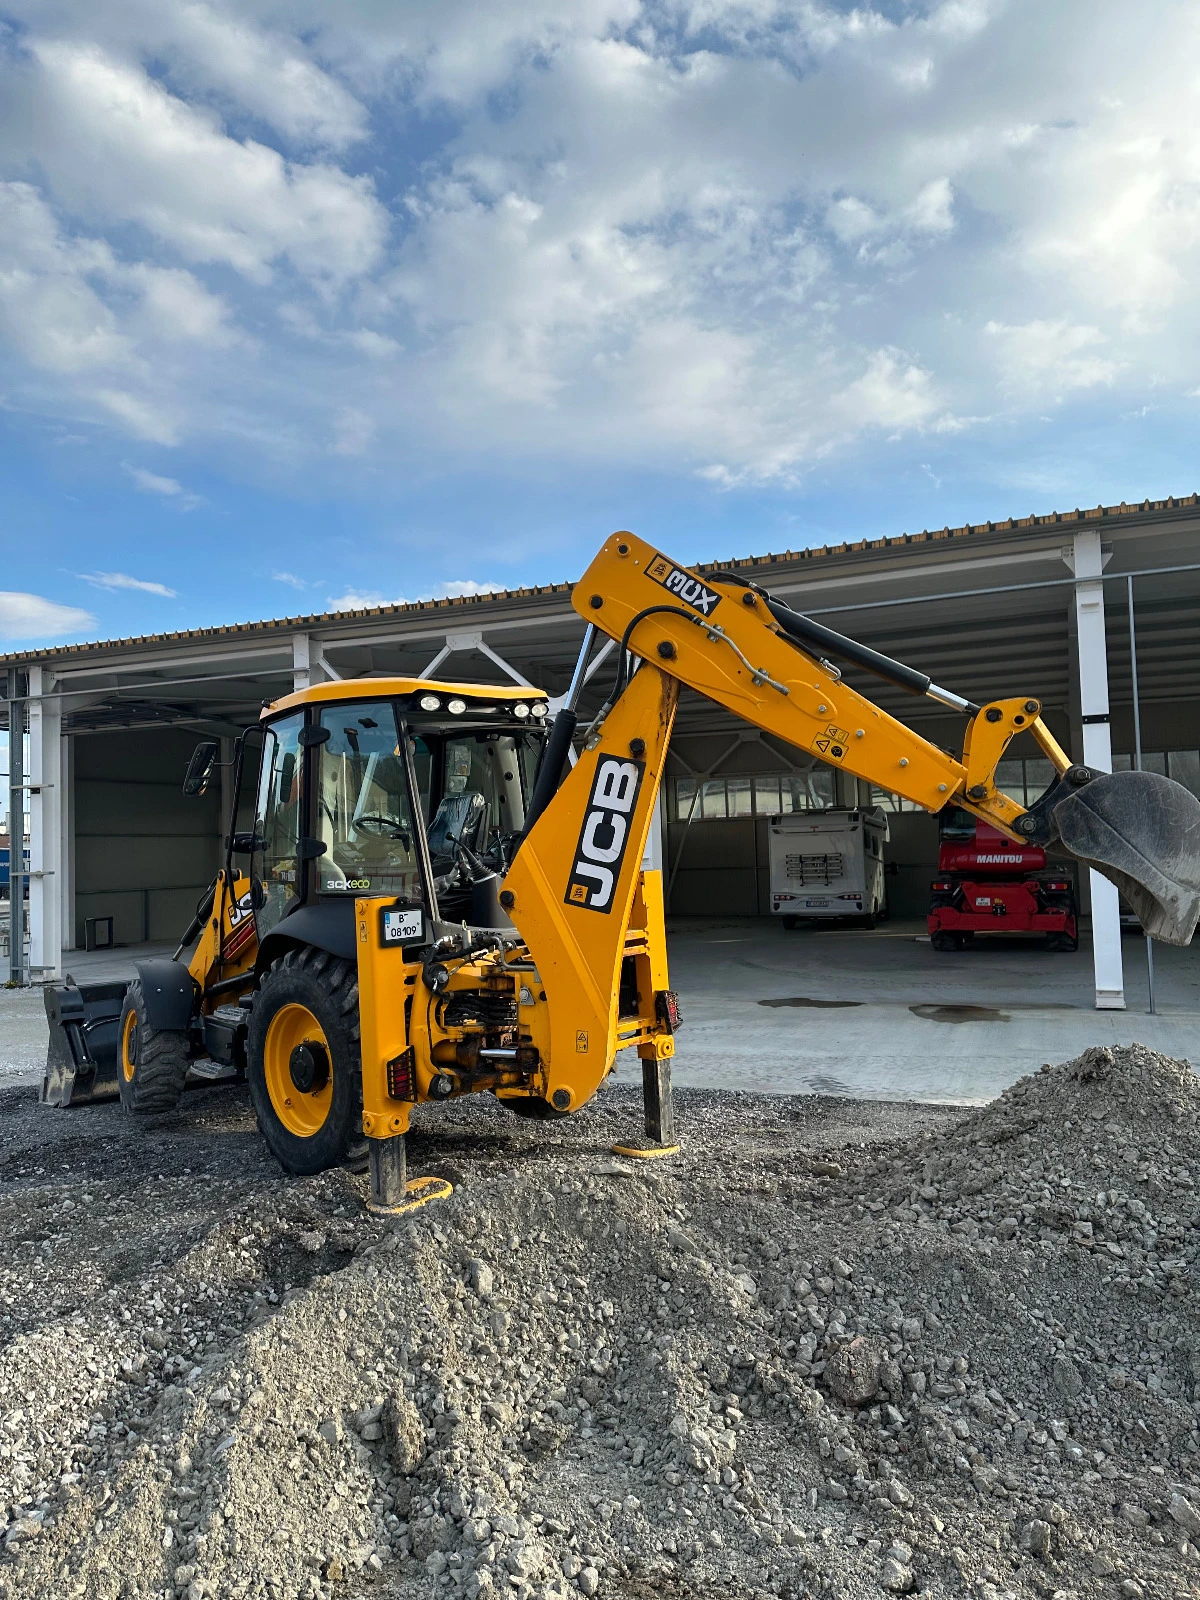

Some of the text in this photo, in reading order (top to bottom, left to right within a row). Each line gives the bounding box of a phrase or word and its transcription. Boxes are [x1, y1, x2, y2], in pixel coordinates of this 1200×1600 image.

[665, 570, 718, 615] 3CX
[575, 760, 639, 907] JCB
[976, 854, 1023, 864] MANITOU
[230, 892, 253, 925] JC
[390, 925, 417, 938] 08109
